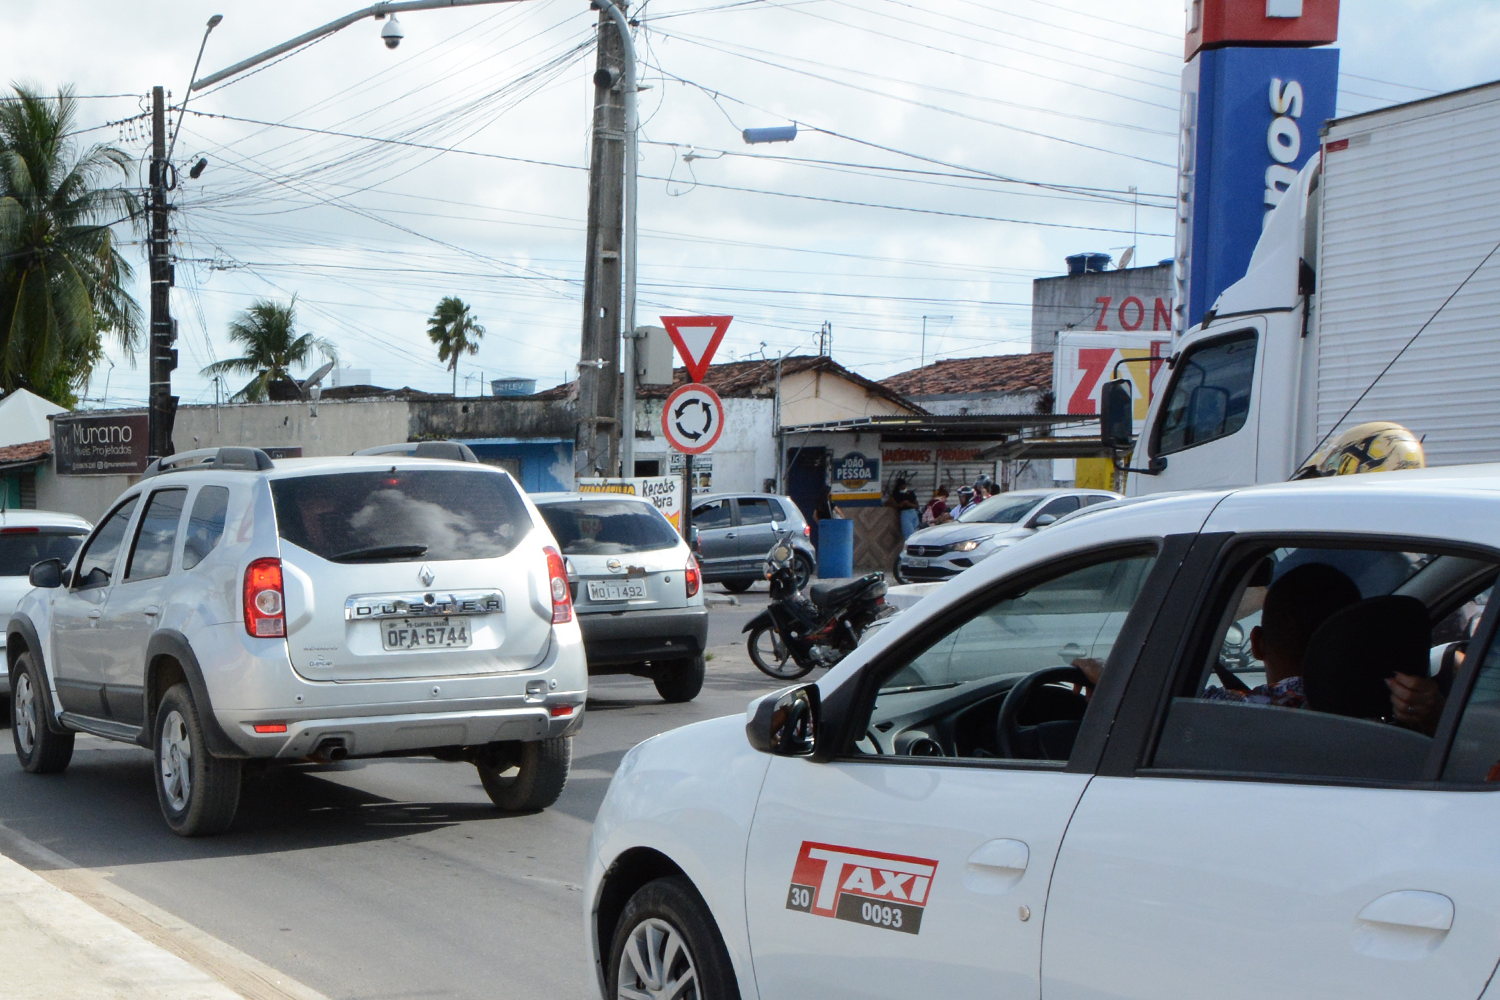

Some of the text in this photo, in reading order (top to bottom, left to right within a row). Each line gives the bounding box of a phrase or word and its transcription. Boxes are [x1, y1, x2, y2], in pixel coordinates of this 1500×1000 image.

[1262, 77, 1303, 232] nos
[73, 424, 132, 444] Murano
[92, 445, 132, 457] Projetados
[842, 456, 864, 468] JOÃO
[837, 469, 871, 479] PESSOA
[356, 600, 500, 616] DUSTER
[808, 848, 934, 910] TAXI
[791, 888, 809, 907] 30
[862, 902, 902, 928] 0093
